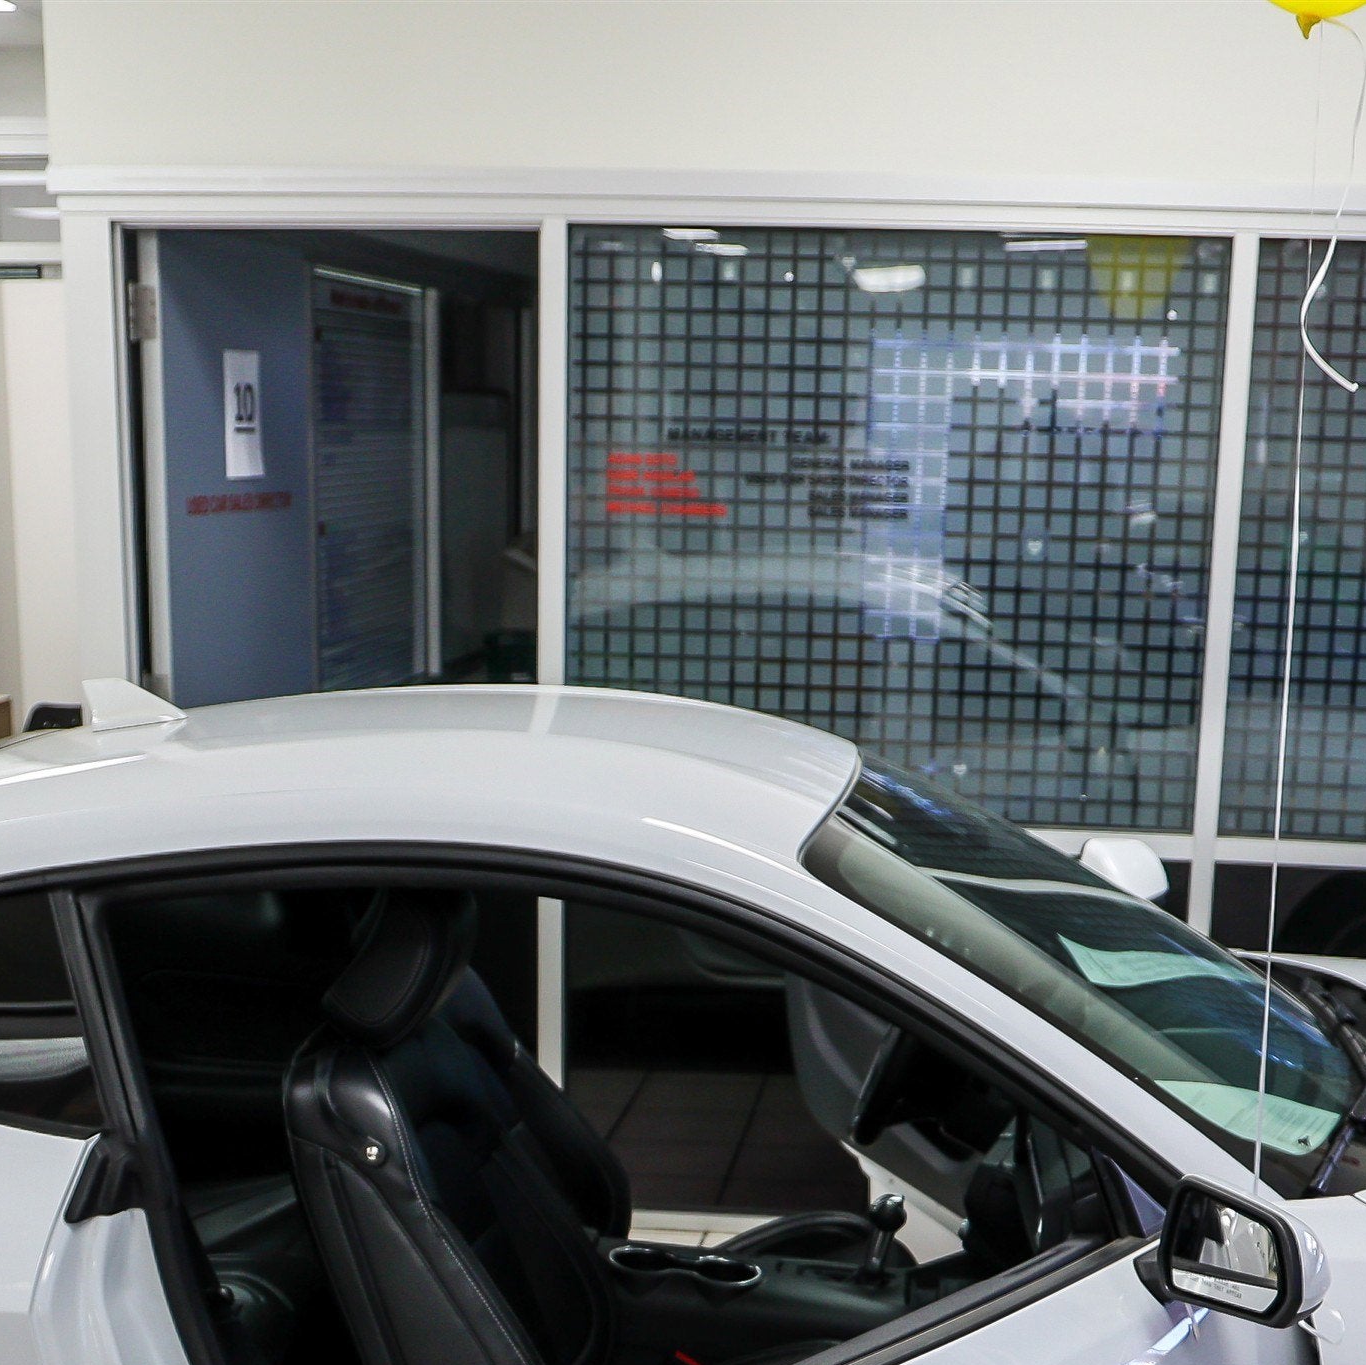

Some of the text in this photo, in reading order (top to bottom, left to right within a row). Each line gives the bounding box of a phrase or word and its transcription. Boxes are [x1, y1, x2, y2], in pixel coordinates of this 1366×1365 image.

[849, 459, 910, 471] MANAGER
[848, 475, 910, 488] DIRECTOR
[848, 490, 909, 503] MANAGER
[807, 504, 909, 518] SALES MANAGER
